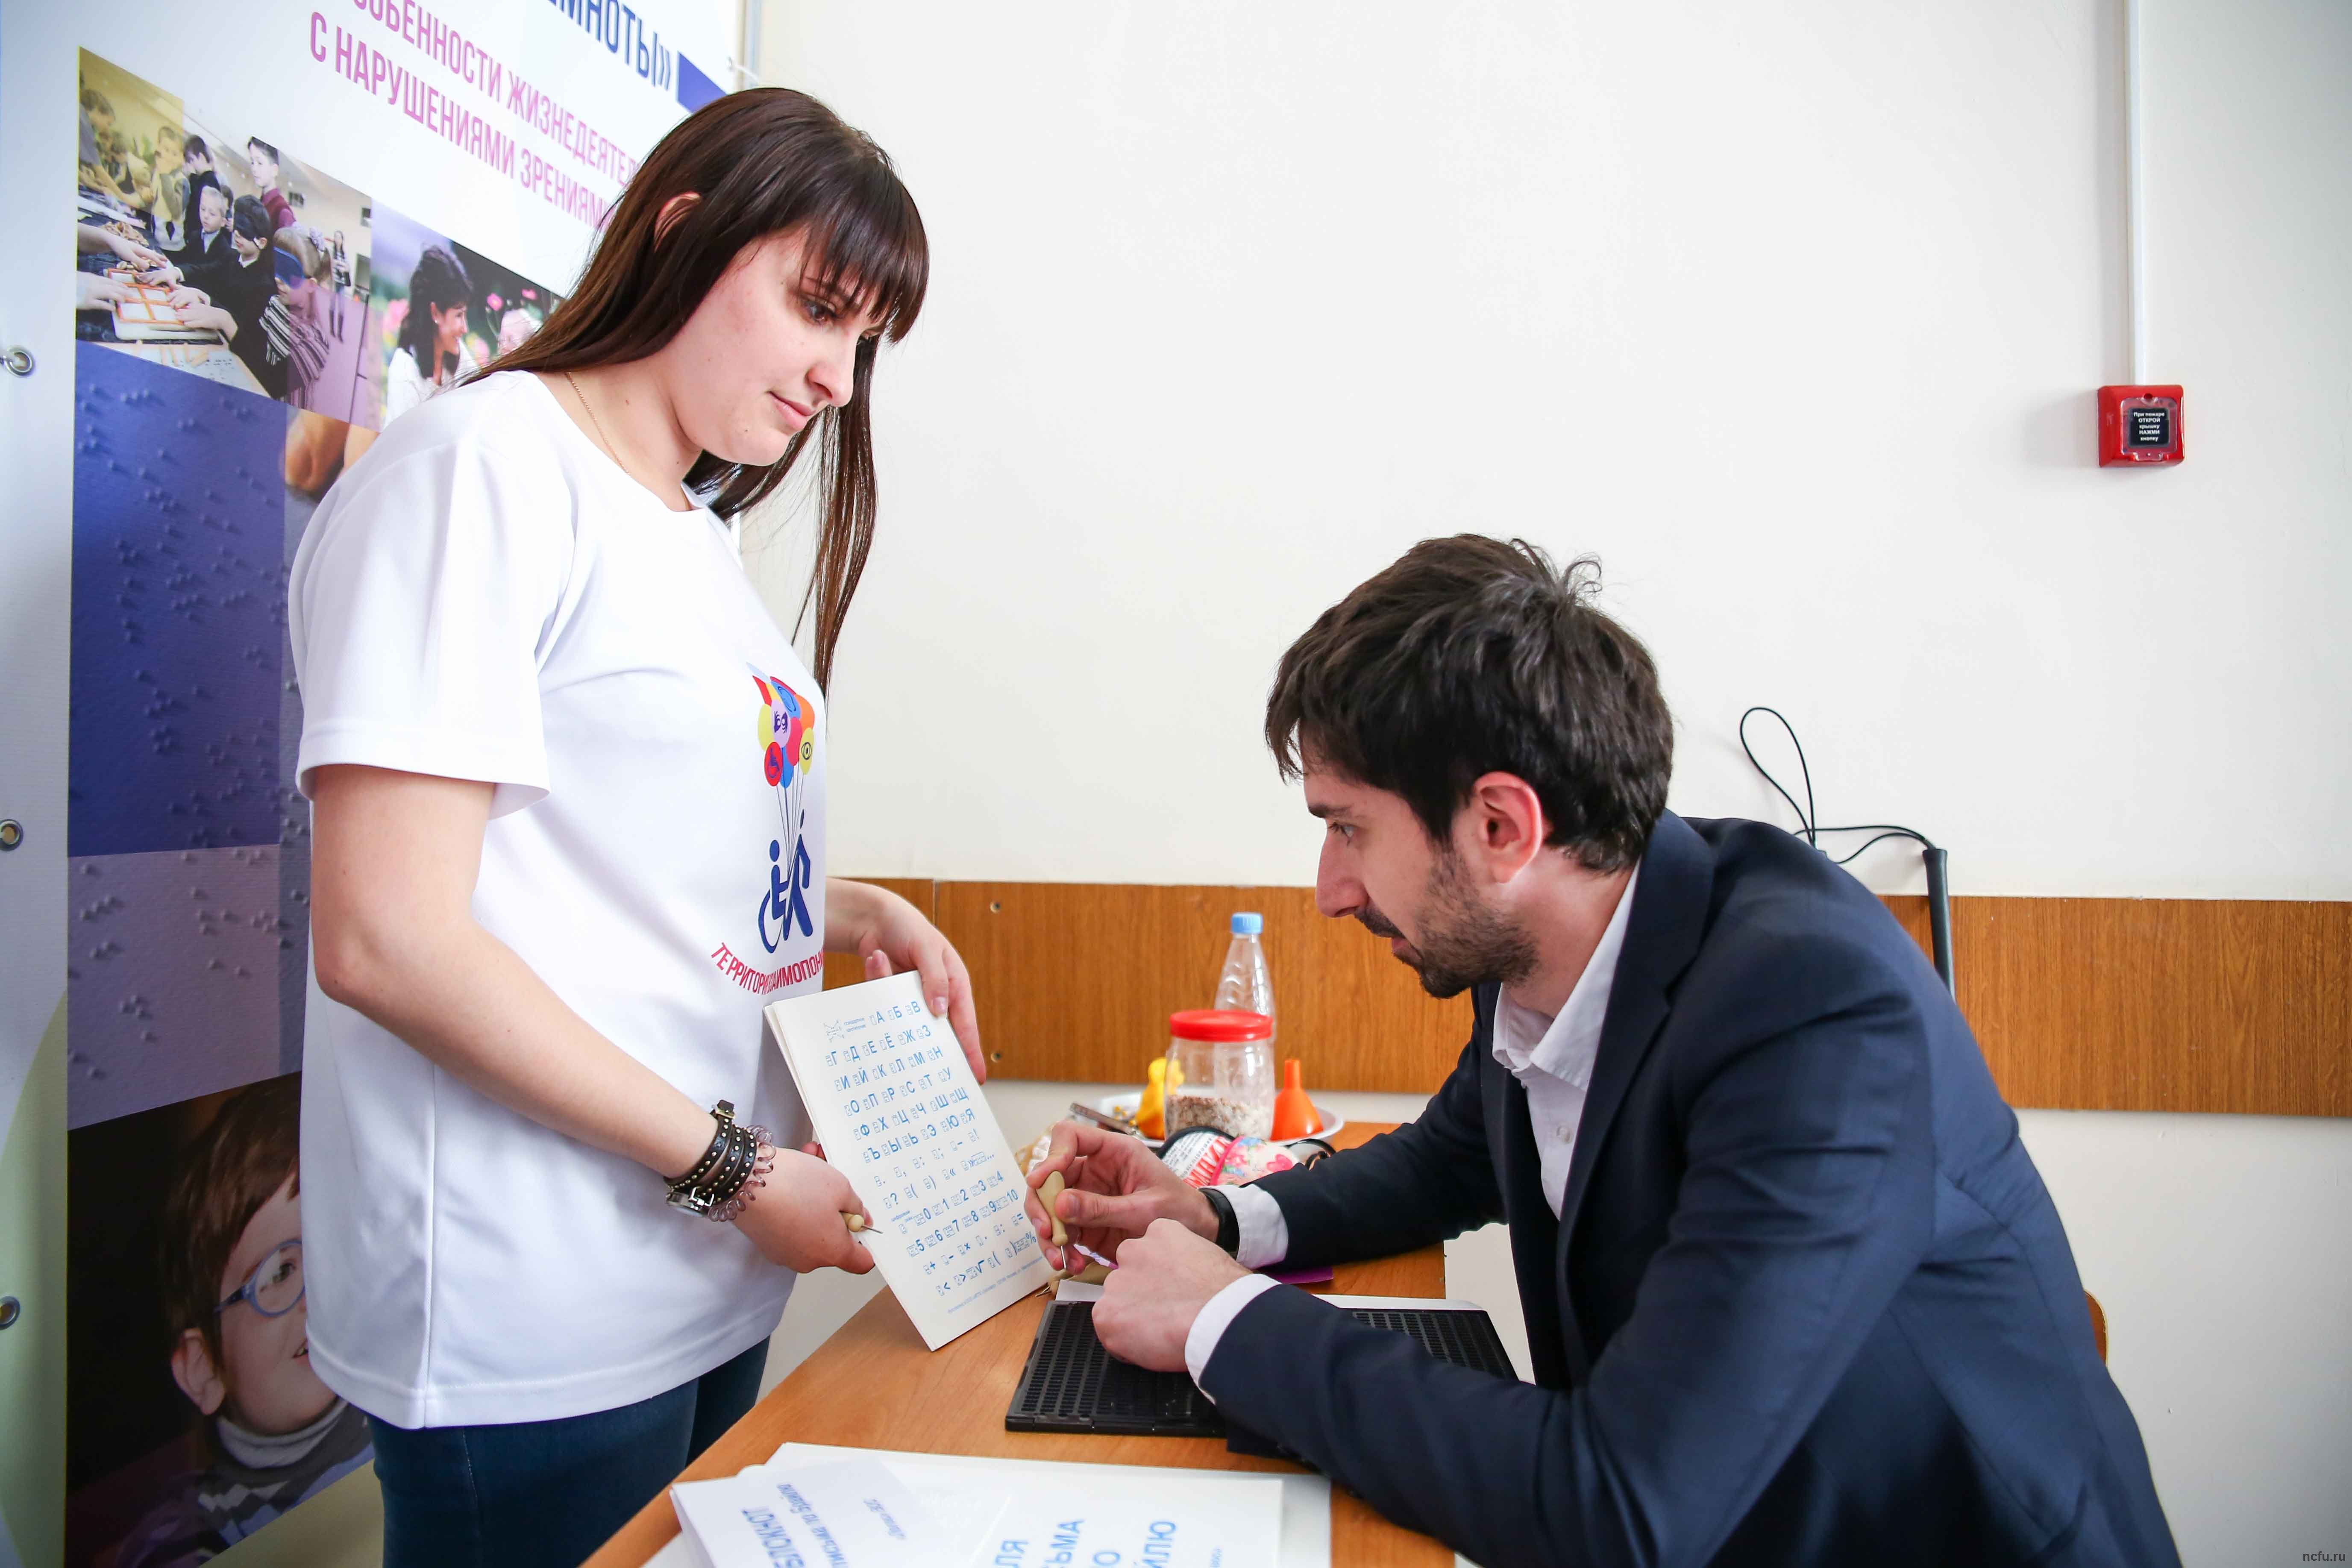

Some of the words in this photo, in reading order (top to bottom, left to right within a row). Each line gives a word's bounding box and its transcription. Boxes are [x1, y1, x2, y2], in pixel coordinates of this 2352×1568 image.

[354, 0, 502, 103] БЕННОСТИ
[548, 0, 670, 91] НОТЫ»
[310, 12, 327, 62] С
[335, 25, 514, 179] НАРУШЕНИЯМИ
[876, 1011, 885, 1023] А
[893, 1006, 902, 1019] Б
[911, 1001, 920, 1013] В
[831, 1051, 837, 1065] Г
[850, 1046, 860, 1062] Д
[868, 1041, 877, 1054] Е
[884, 1033, 895, 1048] Ё
[904, 1029, 916, 1043] Ж
[922, 1025, 931, 1037] З
[840, 1075, 851, 1089] И
[858, 1067, 869, 1084] Й
[877, 1064, 887, 1078] К
[895, 1059, 905, 1072] Л
[913, 1051, 925, 1065] М
[932, 1046, 943, 1059] Н
[850, 1100, 860, 1113] О
[868, 1093, 878, 1107] П
[887, 1087, 895, 1101] Р
[906, 1081, 915, 1093] С
[923, 1074, 933, 1086] Т
[943, 1067, 951, 1080] У
[860, 1124, 870, 1136] Ф
[878, 1117, 888, 1130] Х
[897, 1110, 910, 1124] Ц
[916, 1103, 926, 1115] Ч
[935, 1094, 949, 1108] Ш
[954, 1087, 969, 1101] Щ
[868, 1148, 881, 1160] Ъ
[888, 1137, 902, 1153] Ы
[907, 1133, 918, 1145] Ь
[927, 1124, 937, 1136] Э
[946, 1115, 959, 1129] Ю
[965, 1108, 975, 1122] Я
[923, 1208, 931, 1219] 0
[943, 1198, 949, 1210] 1
[960, 1189, 969, 1201] 2
[978, 1180, 986, 1191] 3
[996, 1171, 1003, 1182] 4
[915, 1239, 924, 1251] 5
[935, 1230, 943, 1241] 6
[952, 1219, 960, 1231] 7
[971, 1210, 979, 1222] 8
[989, 1201, 996, 1212] 9
[1007, 1189, 1018, 1202] 10
[1042, 1519, 1085, 1568] ЬМА
